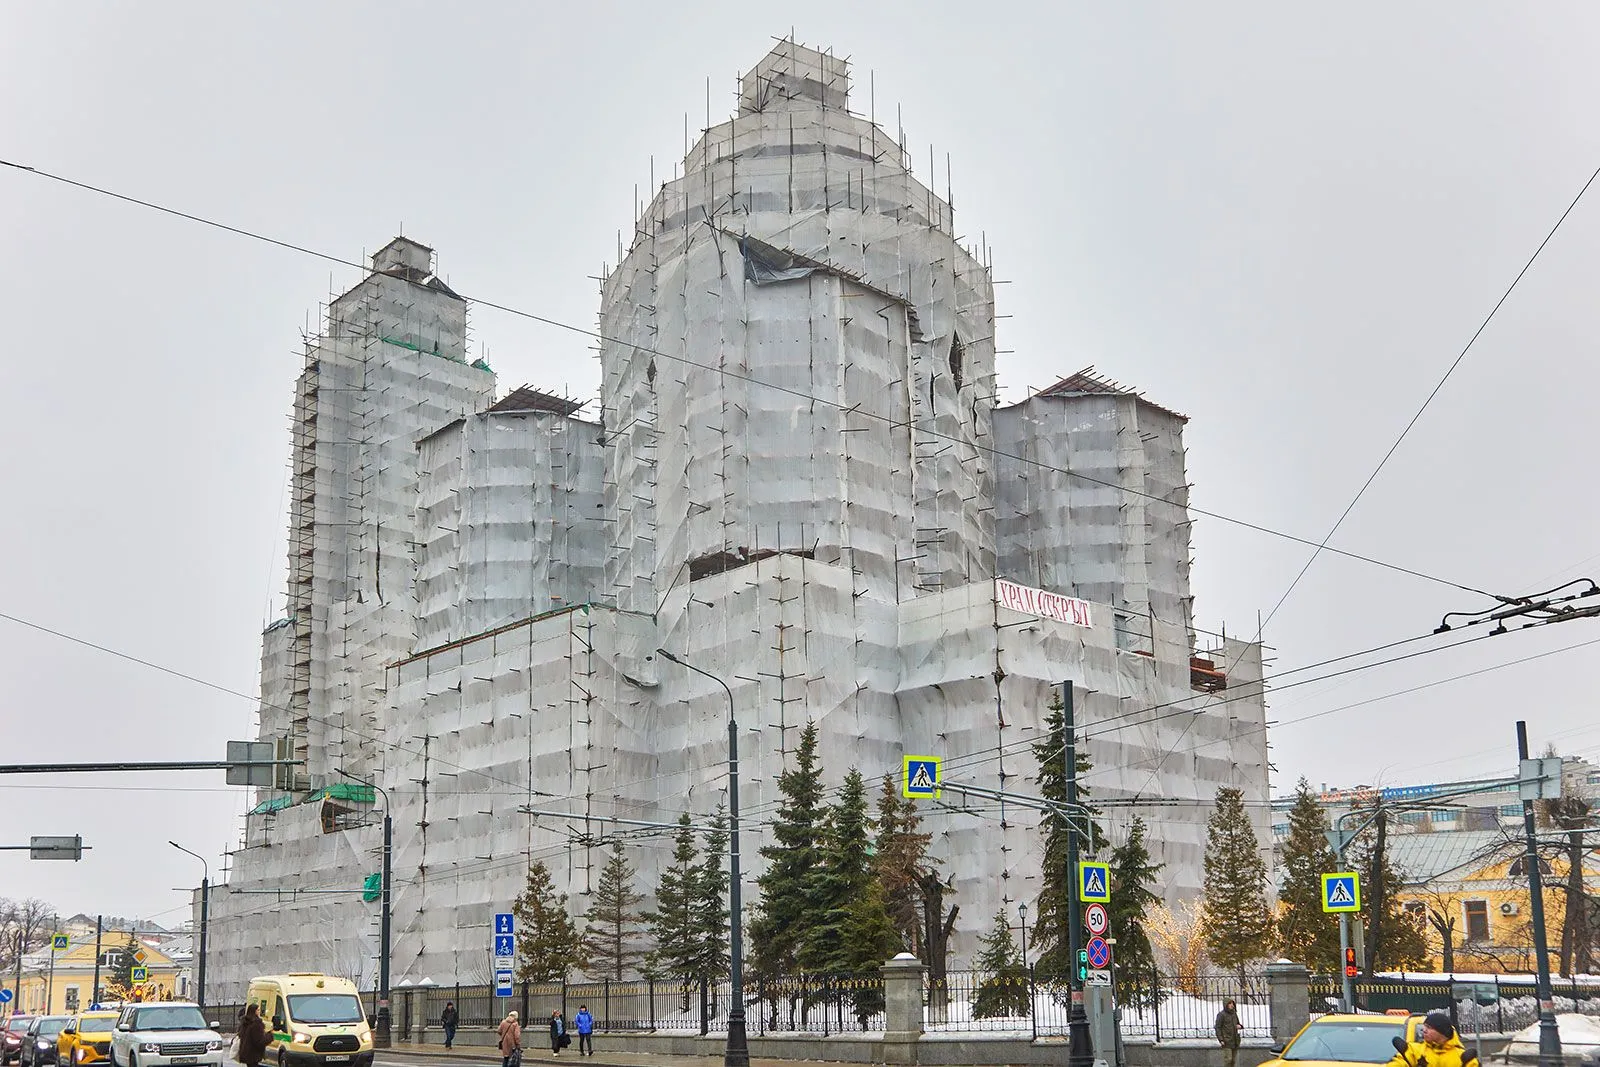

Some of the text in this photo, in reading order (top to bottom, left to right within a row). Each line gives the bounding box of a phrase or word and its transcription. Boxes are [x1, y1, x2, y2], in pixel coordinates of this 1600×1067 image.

[1000, 582, 1089, 626] ХРАМ ОТКРЫТ
[1090, 913, 1103, 926] 50
